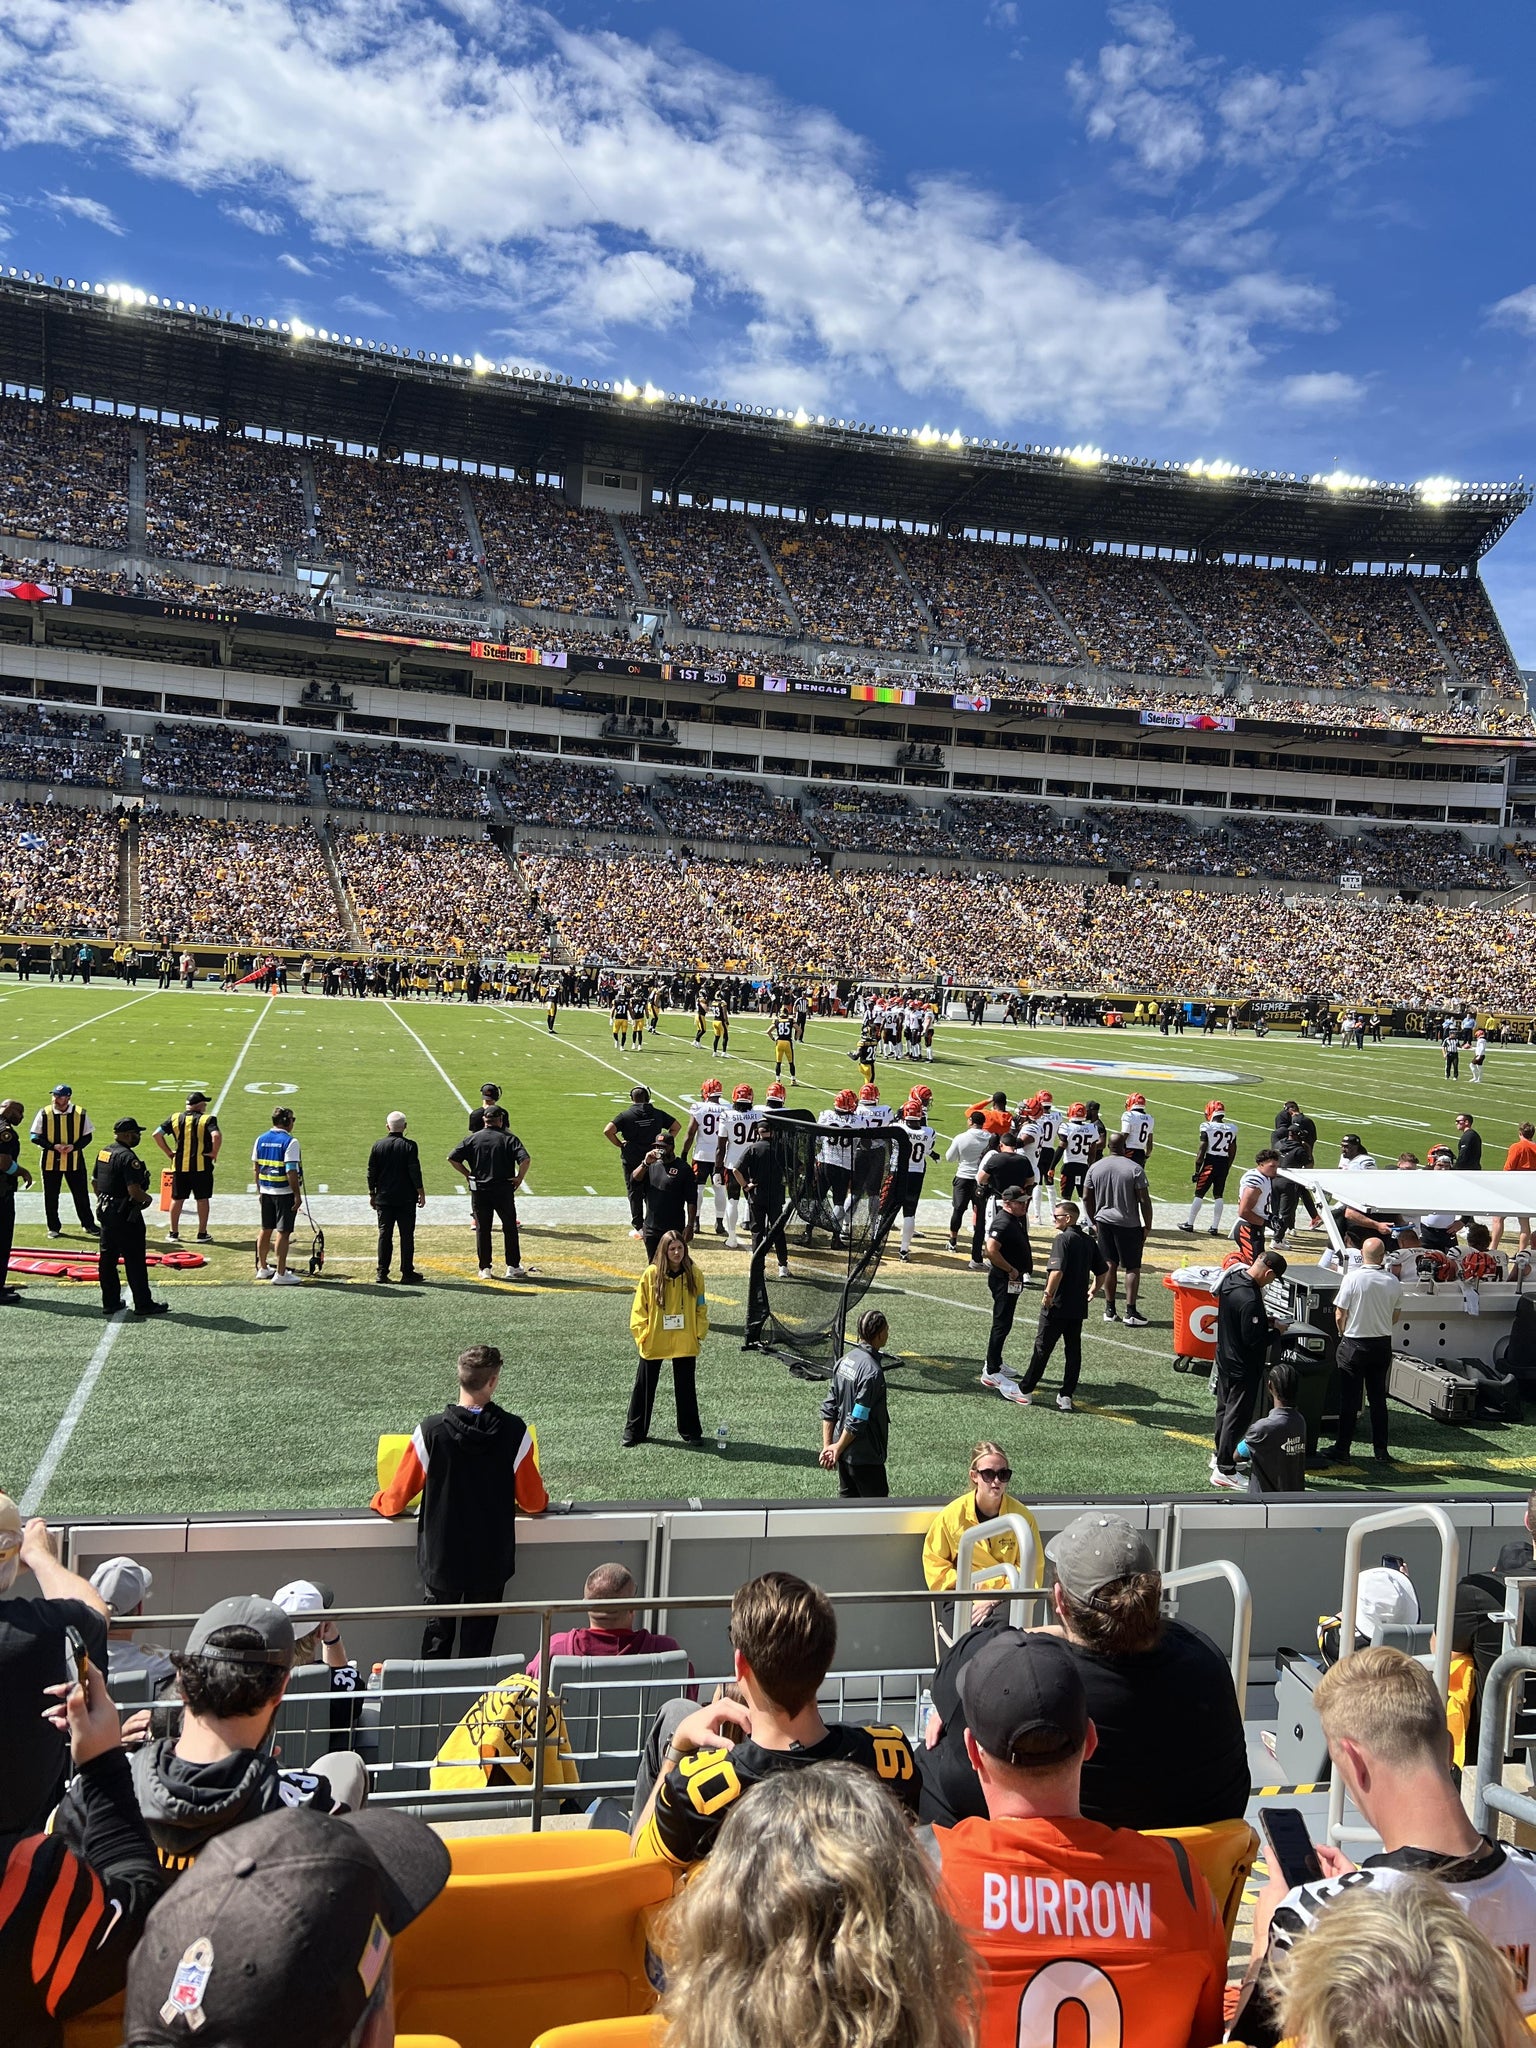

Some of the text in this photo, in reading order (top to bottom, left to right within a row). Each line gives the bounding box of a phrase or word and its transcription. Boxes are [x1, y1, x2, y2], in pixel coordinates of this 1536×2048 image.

[483, 644, 526, 661] Steelers
[551, 653, 559, 664] 7
[597, 661, 640, 673] & ON
[679, 669, 727, 684] 1ST 5:50
[742, 676, 752, 686] 25
[770, 679, 779, 689] 7
[794, 683, 847, 695] BENGALS
[1147, 712, 1180, 726] Steelers
[617, 1005, 626, 1014] 21
[633, 1004, 644, 1014] 44
[778, 1022, 790, 1036] 85
[733, 1121, 757, 1145] 94
[1138, 1122, 1148, 1143] 6
[1071, 1134, 1093, 1155] 35
[1211, 1130, 1233, 1152] 23
[1189, 1305, 1219, 1343] G
[982, 1872, 1151, 1939] BURROW
